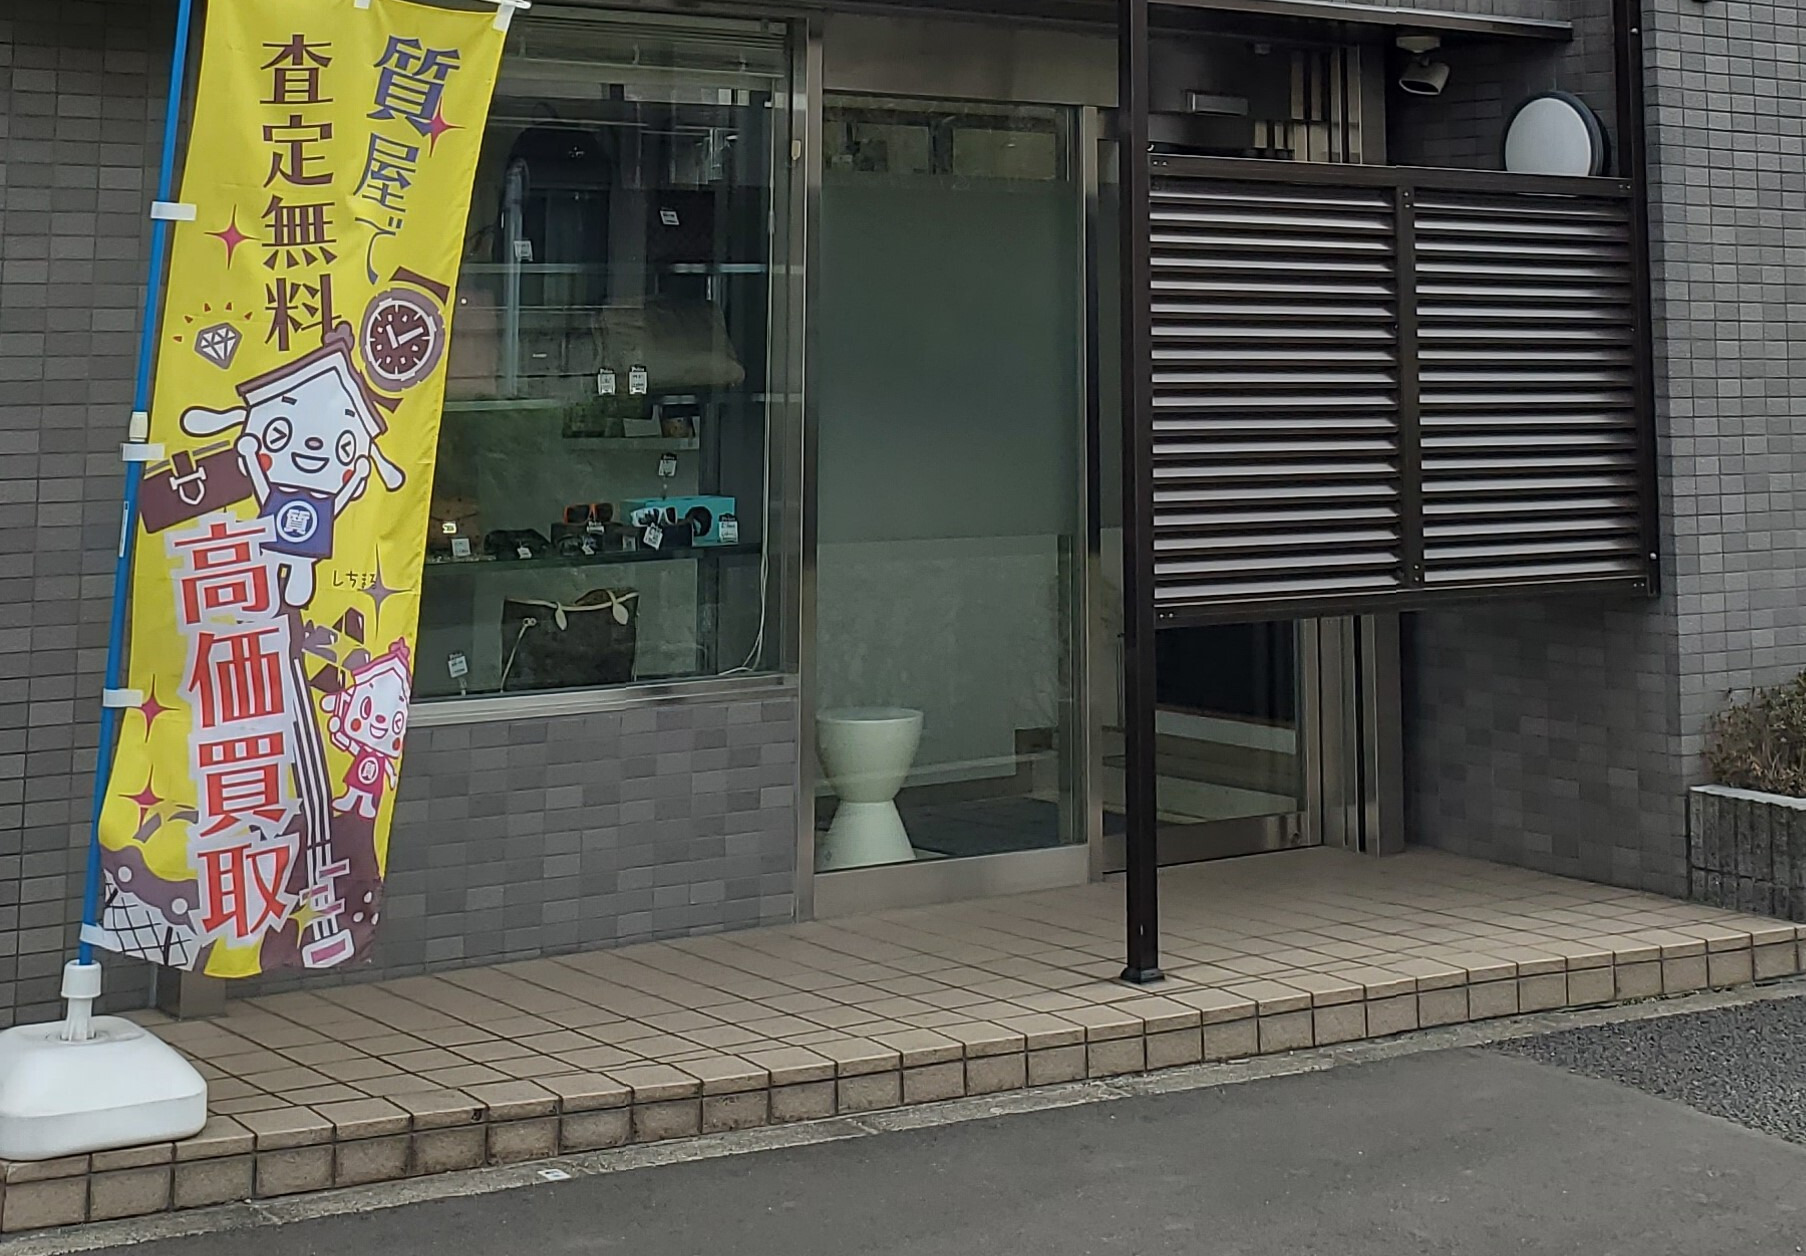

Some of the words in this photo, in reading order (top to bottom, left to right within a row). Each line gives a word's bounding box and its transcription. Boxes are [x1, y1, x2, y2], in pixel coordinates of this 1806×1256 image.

[259, 33, 342, 352] 査定無料
[353, 34, 460, 285] 質屋で
[173, 522, 293, 939] 高価買取
